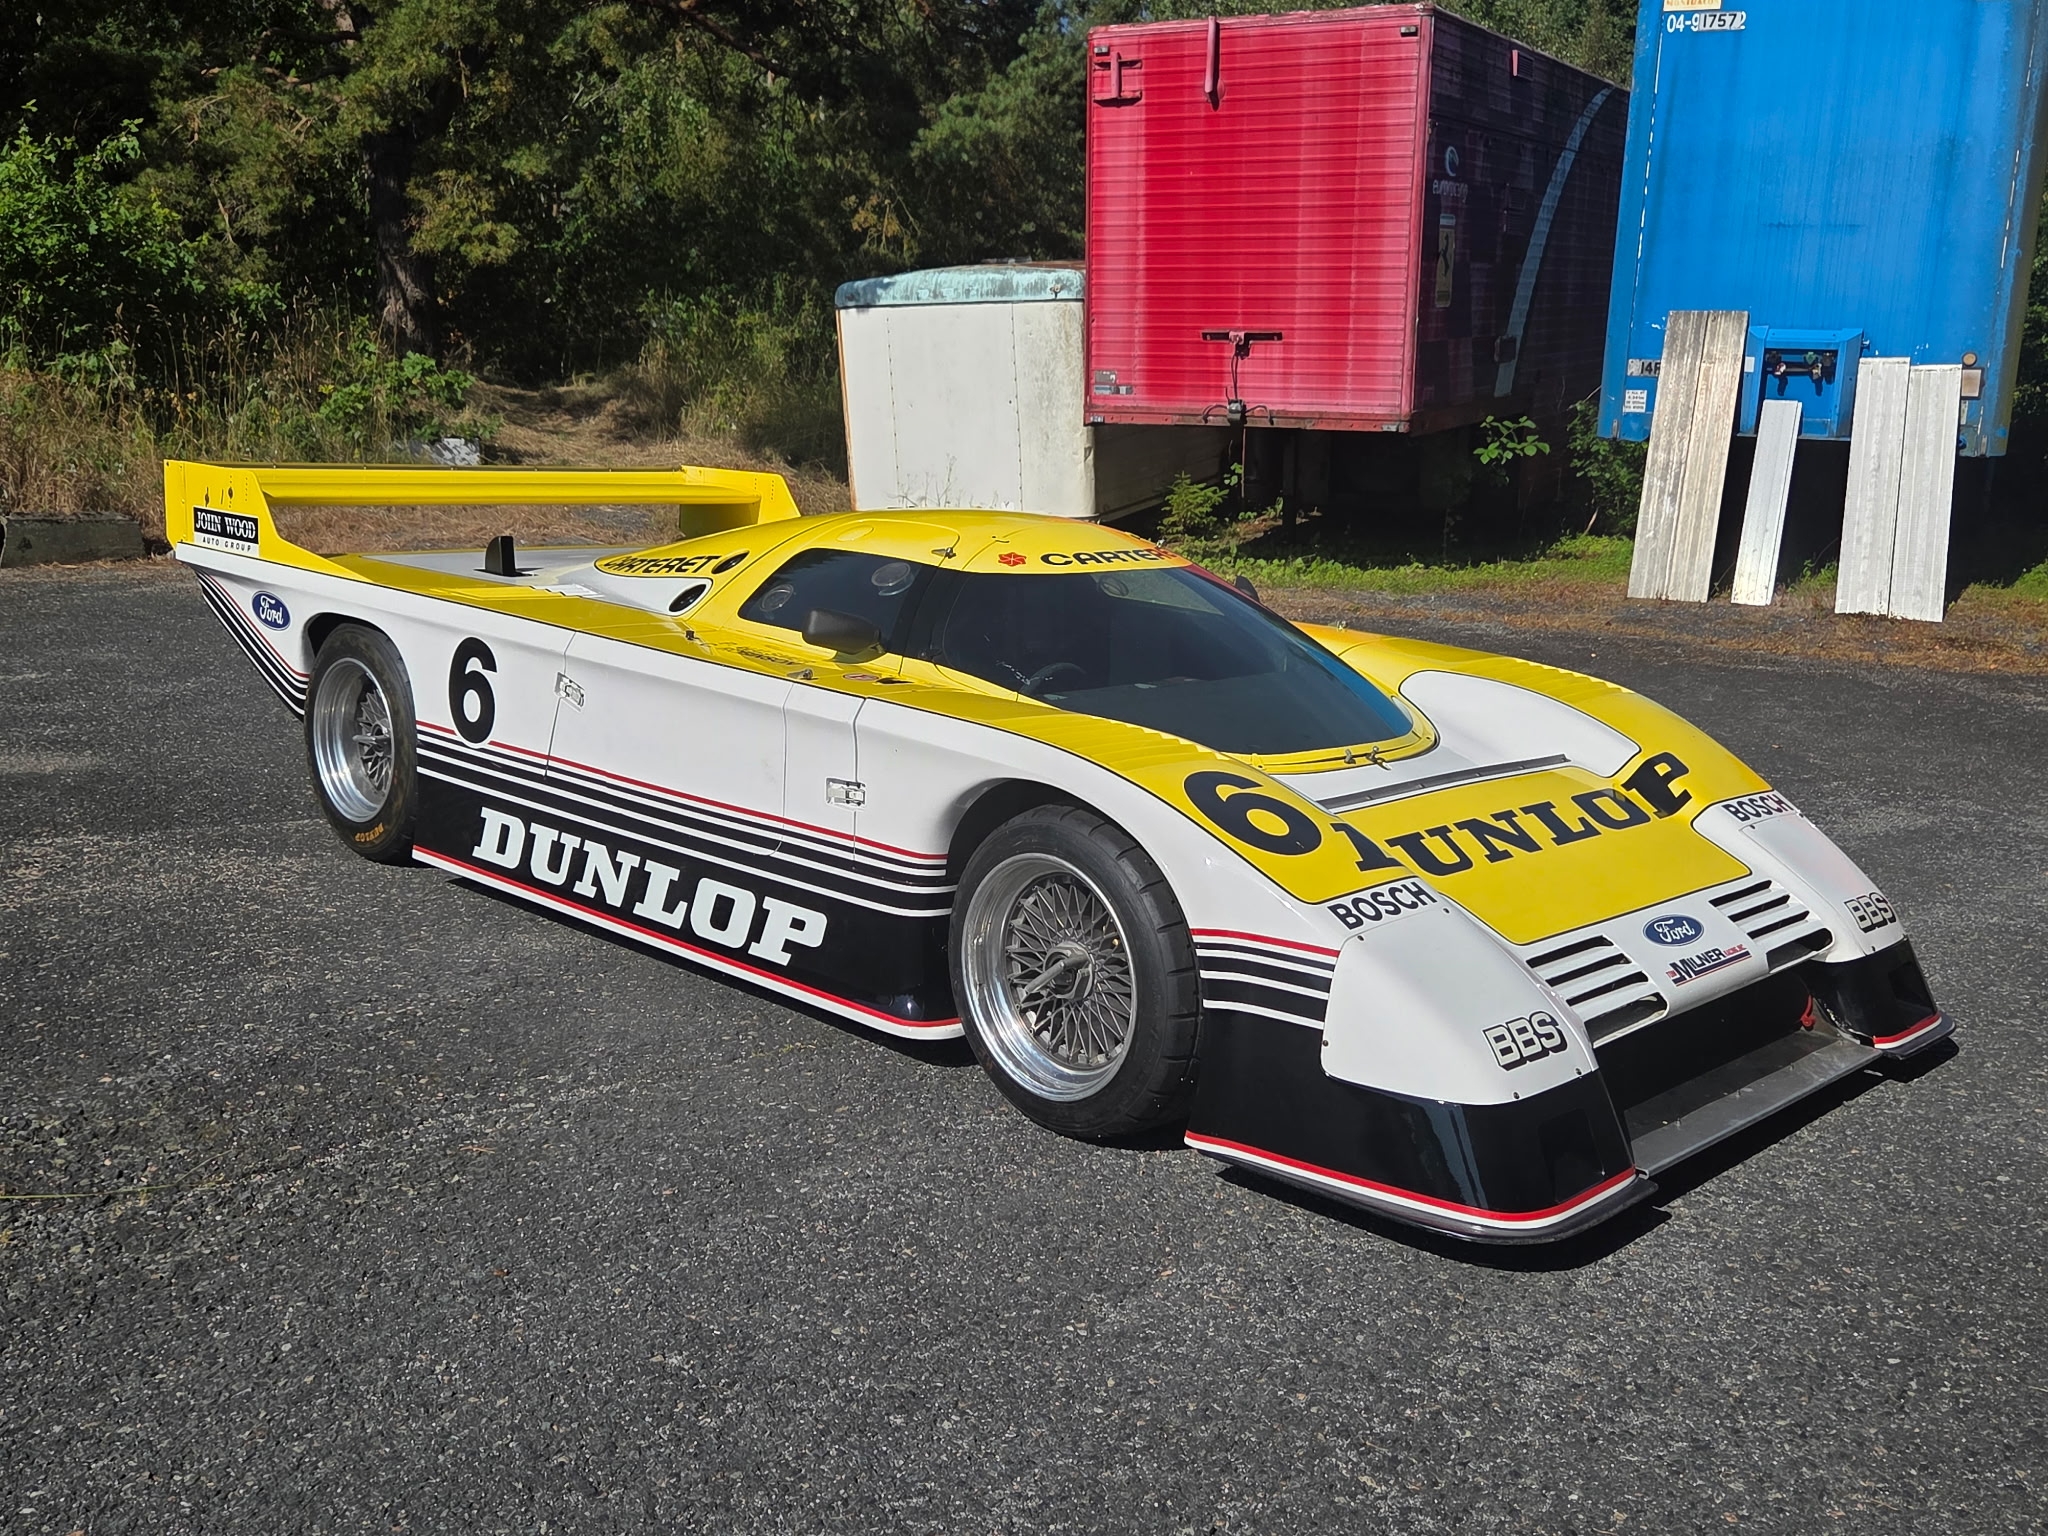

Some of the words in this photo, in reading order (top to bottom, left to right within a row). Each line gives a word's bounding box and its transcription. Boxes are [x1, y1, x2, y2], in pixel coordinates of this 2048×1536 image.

[195, 511, 221, 533] JOHN
[224, 516, 256, 539] WOOD
[202, 536, 220, 546] AUTO
[224, 541, 251, 552] GROUP
[603, 555, 722, 574] CARTERET
[260, 595, 284, 624] Ford
[448, 636, 498, 744] 6
[1183, 770, 1323, 856] 6
[1722, 793, 1795, 823] BOSCH
[471, 806, 828, 967] DUNLOP
[1327, 881, 1438, 930] BOSCH
[1843, 891, 1897, 934] BBS
[1653, 918, 1696, 943] Ford
[1669, 947, 1726, 979] MILNER
[1481, 1010, 1568, 1072] BBS
